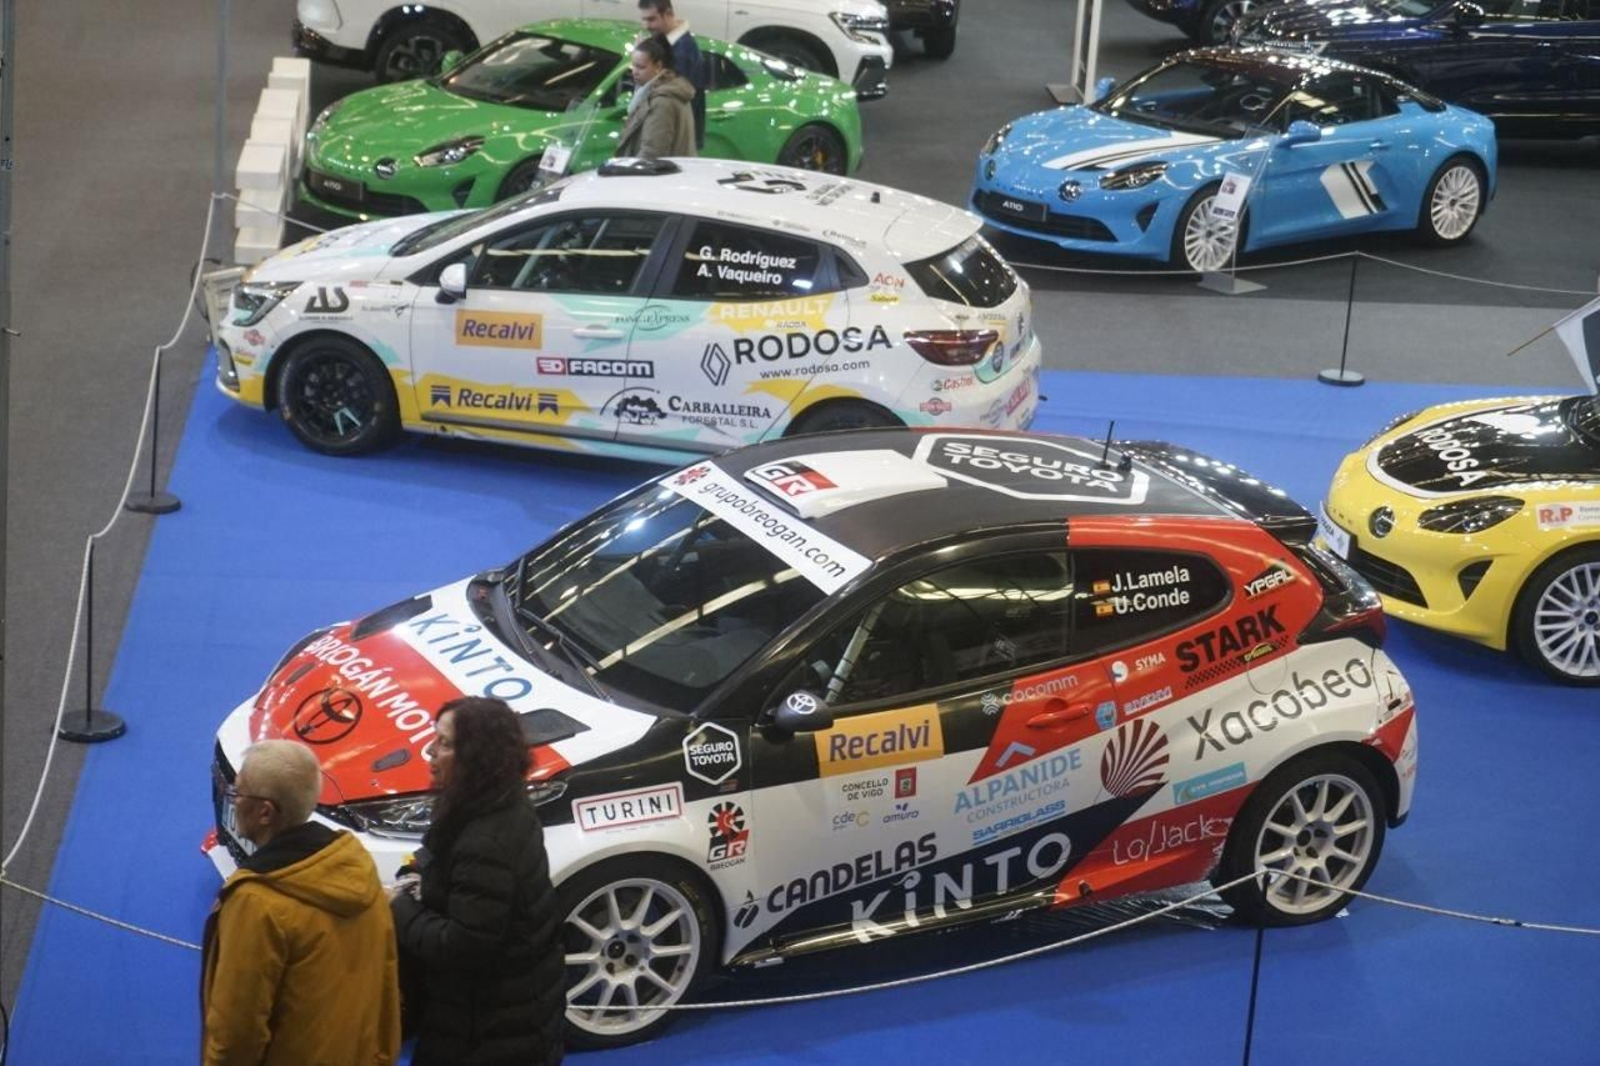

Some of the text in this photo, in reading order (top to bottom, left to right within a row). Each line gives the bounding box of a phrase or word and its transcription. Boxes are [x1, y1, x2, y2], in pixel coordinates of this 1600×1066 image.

[1002, 200, 1024, 211] A110
[700, 245, 796, 269] G. Rodríguez
[697, 264, 782, 285] A. Vaqueiro
[720, 299, 827, 319] RENAULT
[462, 319, 536, 340] Recalvi
[734, 325, 892, 365] RODOSA
[570, 360, 651, 376] FACOM
[760, 359, 870, 379] www.rodosa.com
[457, 388, 532, 411] Recalvi
[668, 395, 772, 419] CARBALLEIRA
[682, 416, 736, 428] FORESTAL
[943, 442, 1124, 482] SEGURO
[943, 453, 1119, 492] TOYOTA
[763, 464, 817, 496] GR
[698, 481, 846, 578] grupobreogan.com
[1111, 565, 1190, 593] J.Lamela
[1114, 588, 1190, 615] U.Conde
[1174, 605, 1287, 674] STARK
[1135, 652, 1166, 671] SYMA
[1002, 674, 1079, 705] cocomm
[1187, 658, 1372, 761] Xacobeo
[690, 740, 734, 755] SEGURO
[829, 719, 931, 763] Recalvi
[692, 752, 735, 766] TOYOTA
[842, 777, 889, 793] CONCELLO
[954, 748, 1083, 814] ALPANIDE
[847, 788, 883, 801] DE VIGO
[966, 778, 1070, 823] CONSTRUCTORA
[586, 794, 672, 824] TURINI
[708, 840, 746, 862] GR
[767, 832, 937, 913] CANDELAS
